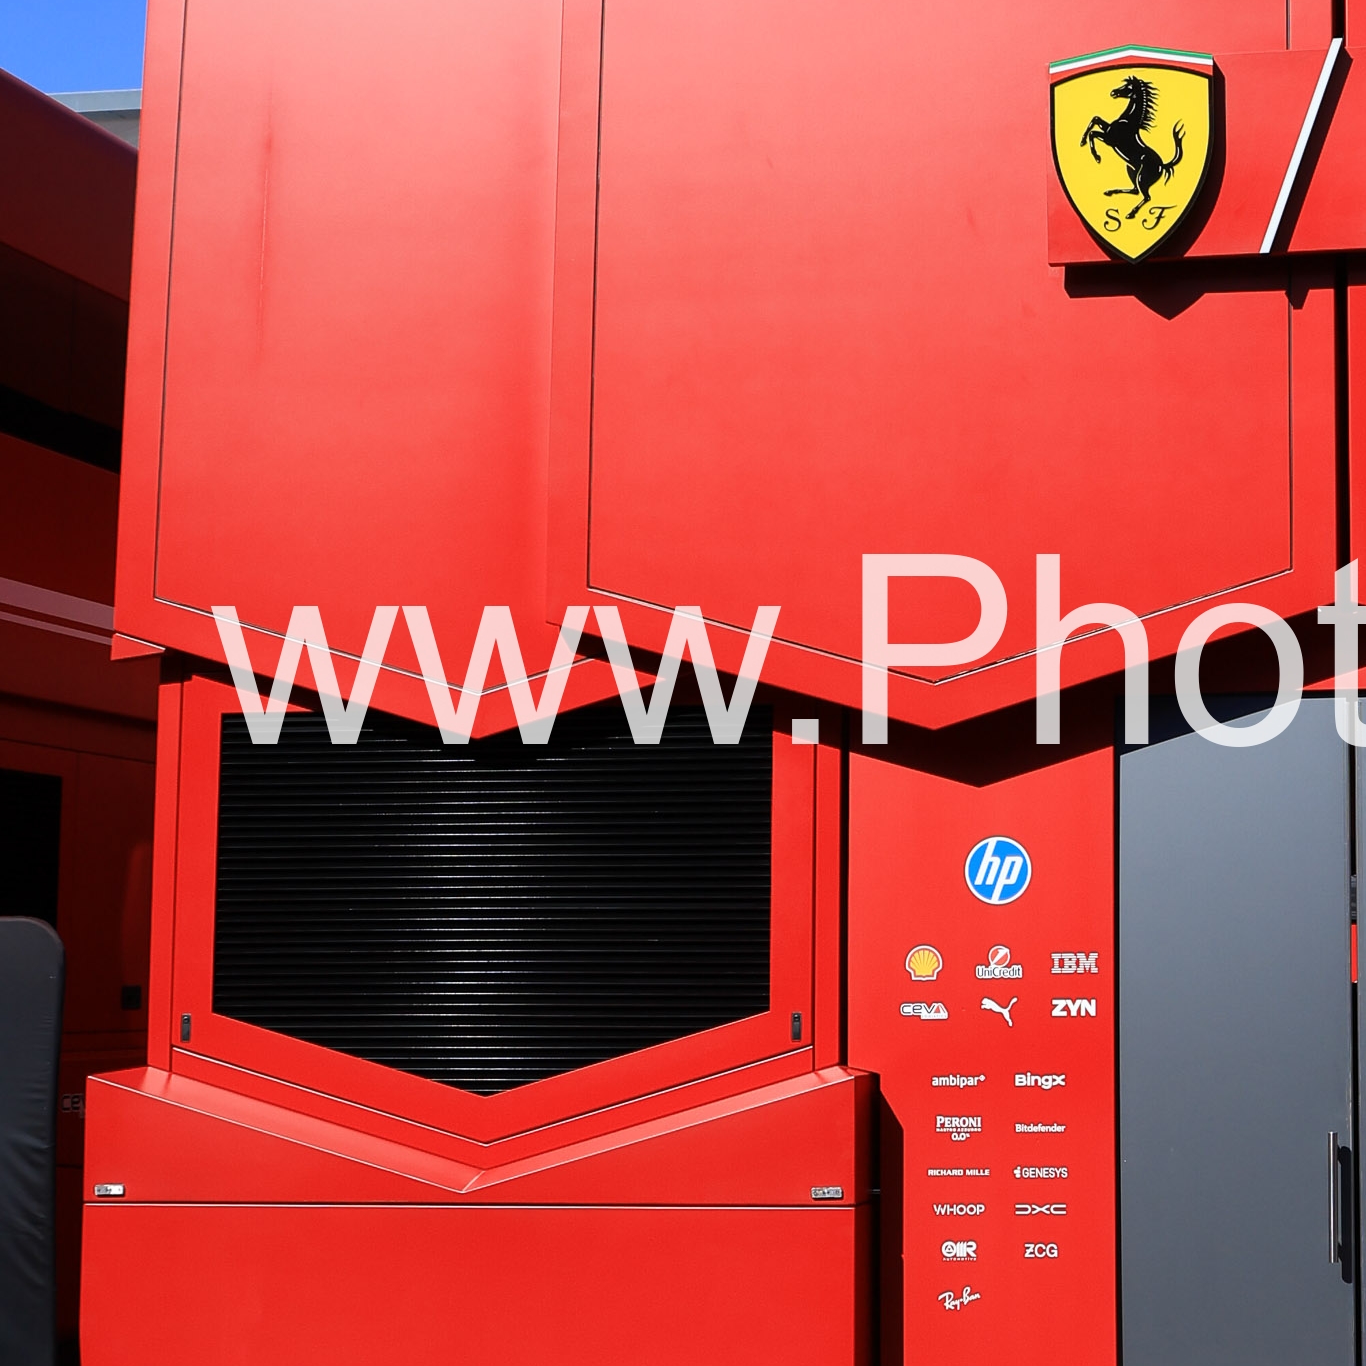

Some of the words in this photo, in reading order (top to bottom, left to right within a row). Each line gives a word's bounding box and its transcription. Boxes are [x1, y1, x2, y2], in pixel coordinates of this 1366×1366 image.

[973, 838, 1024, 901] hp
[1051, 953, 1098, 973] IBM
[976, 966, 1021, 977] UniCredit
[1052, 999, 1096, 1016] ZYN
[936, 1115, 982, 1128] PERONI
[1016, 1123, 1065, 1132] Bitdefender
[1022, 1168, 1067, 1178] GENESYS
[934, 1204, 985, 1215] WHOOP
[1025, 1244, 1057, 1257] ZCG
